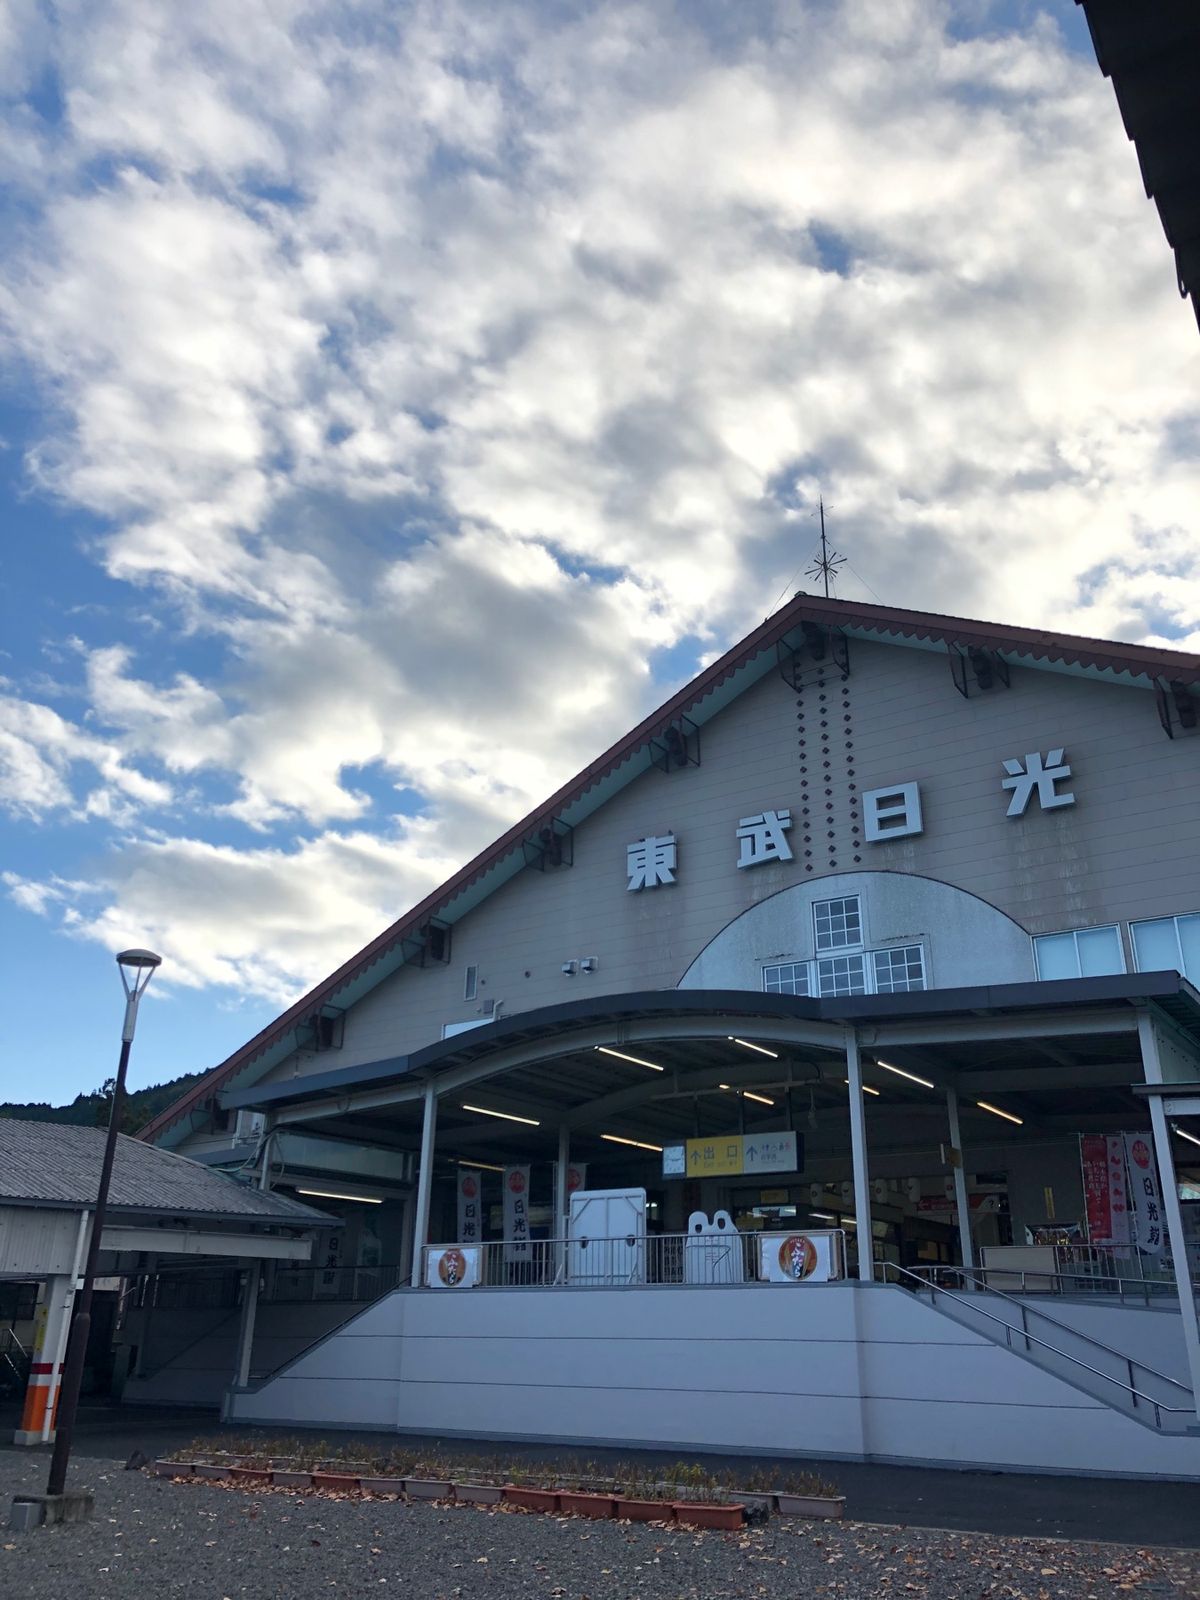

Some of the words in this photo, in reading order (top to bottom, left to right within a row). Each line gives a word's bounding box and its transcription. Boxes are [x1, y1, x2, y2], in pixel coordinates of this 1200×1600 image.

[627, 747, 1075, 891] 東武日光
[703, 1144, 738, 1160] 出口
[463, 1203, 476, 1242] 日光
